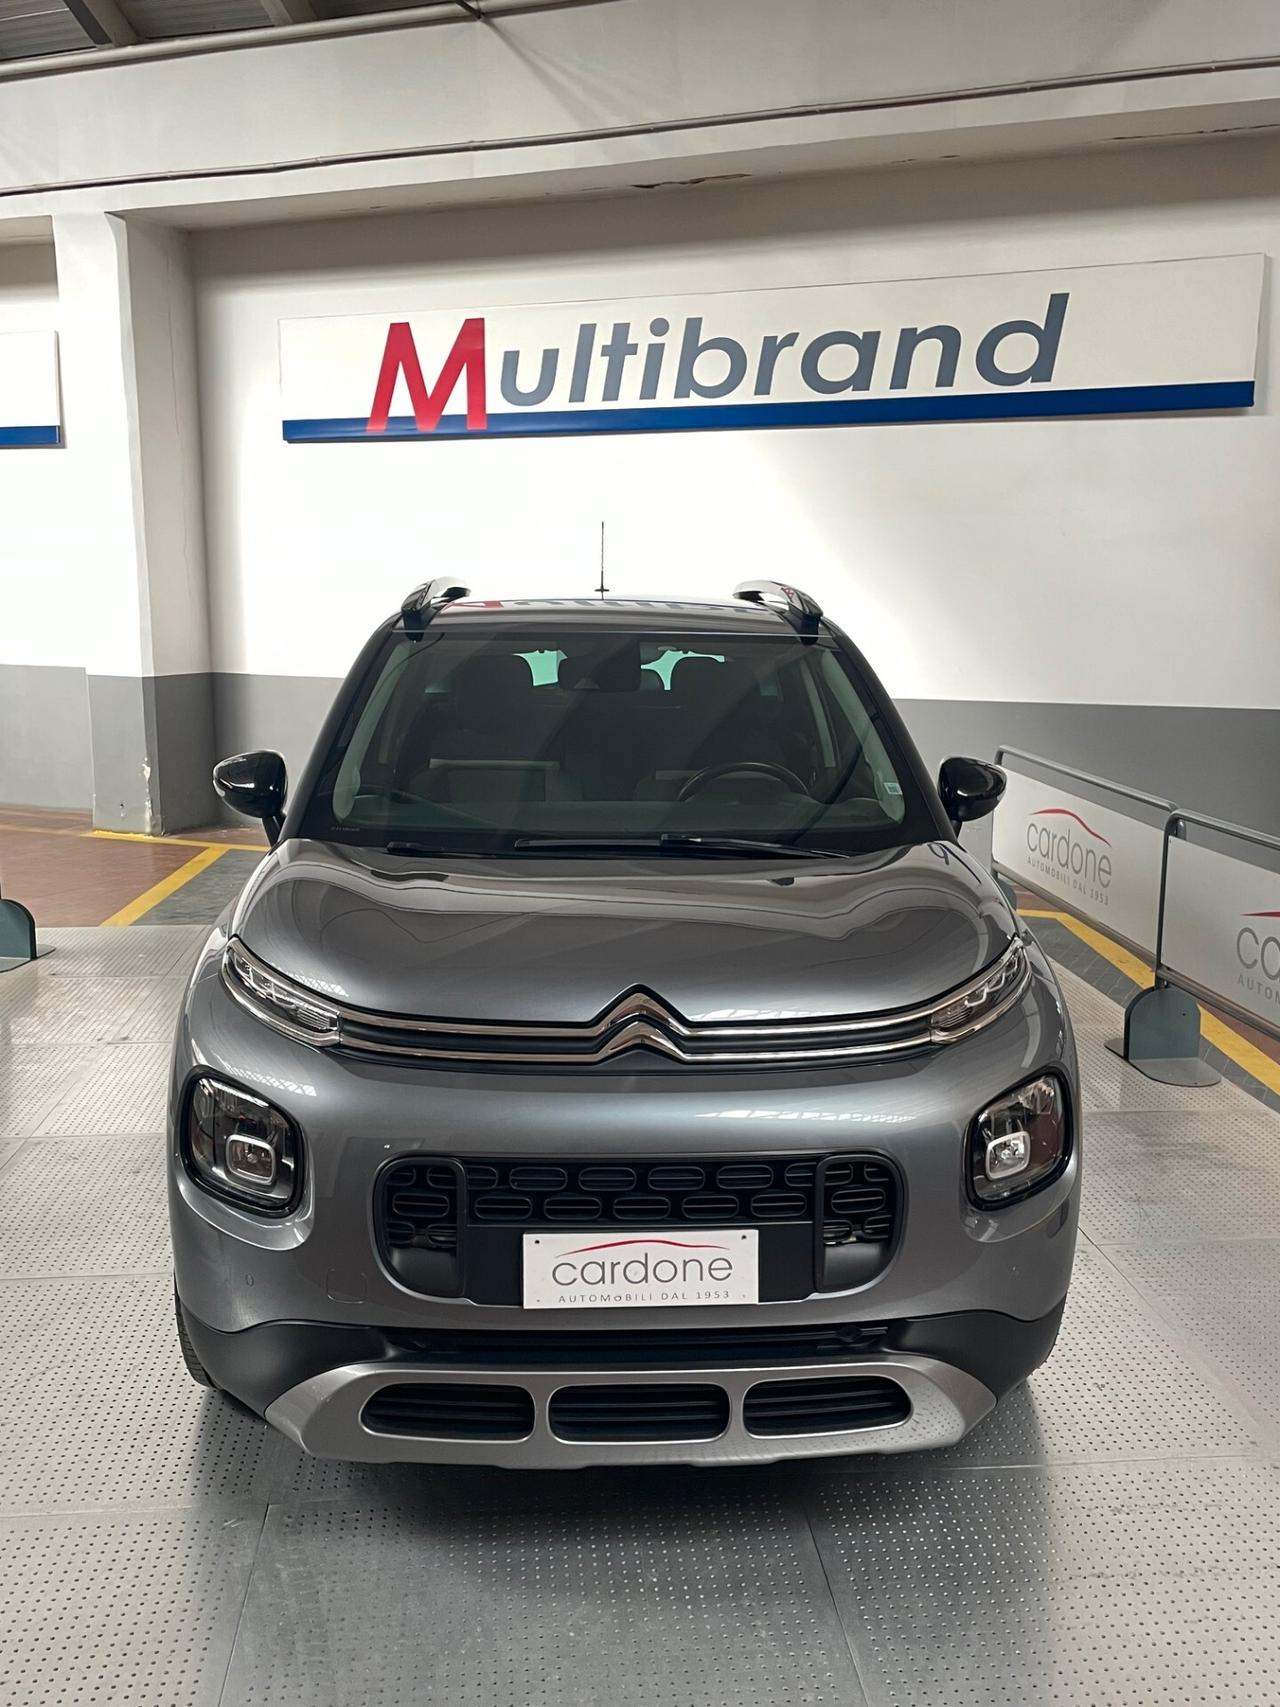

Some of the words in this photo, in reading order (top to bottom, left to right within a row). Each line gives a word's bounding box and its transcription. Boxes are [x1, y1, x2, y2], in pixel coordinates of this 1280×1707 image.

[366, 292, 1070, 433] Multibrand
[1027, 823, 1112, 888] cardone
[1027, 856, 1070, 886] AUTOMOBILI
[1073, 879, 1086, 895] DAL
[552, 1252, 732, 1286] cardone
[558, 1293, 652, 1303] AUTOMOBILI
[661, 1292, 687, 1301] DAL
[696, 1291, 729, 1300] 1953
